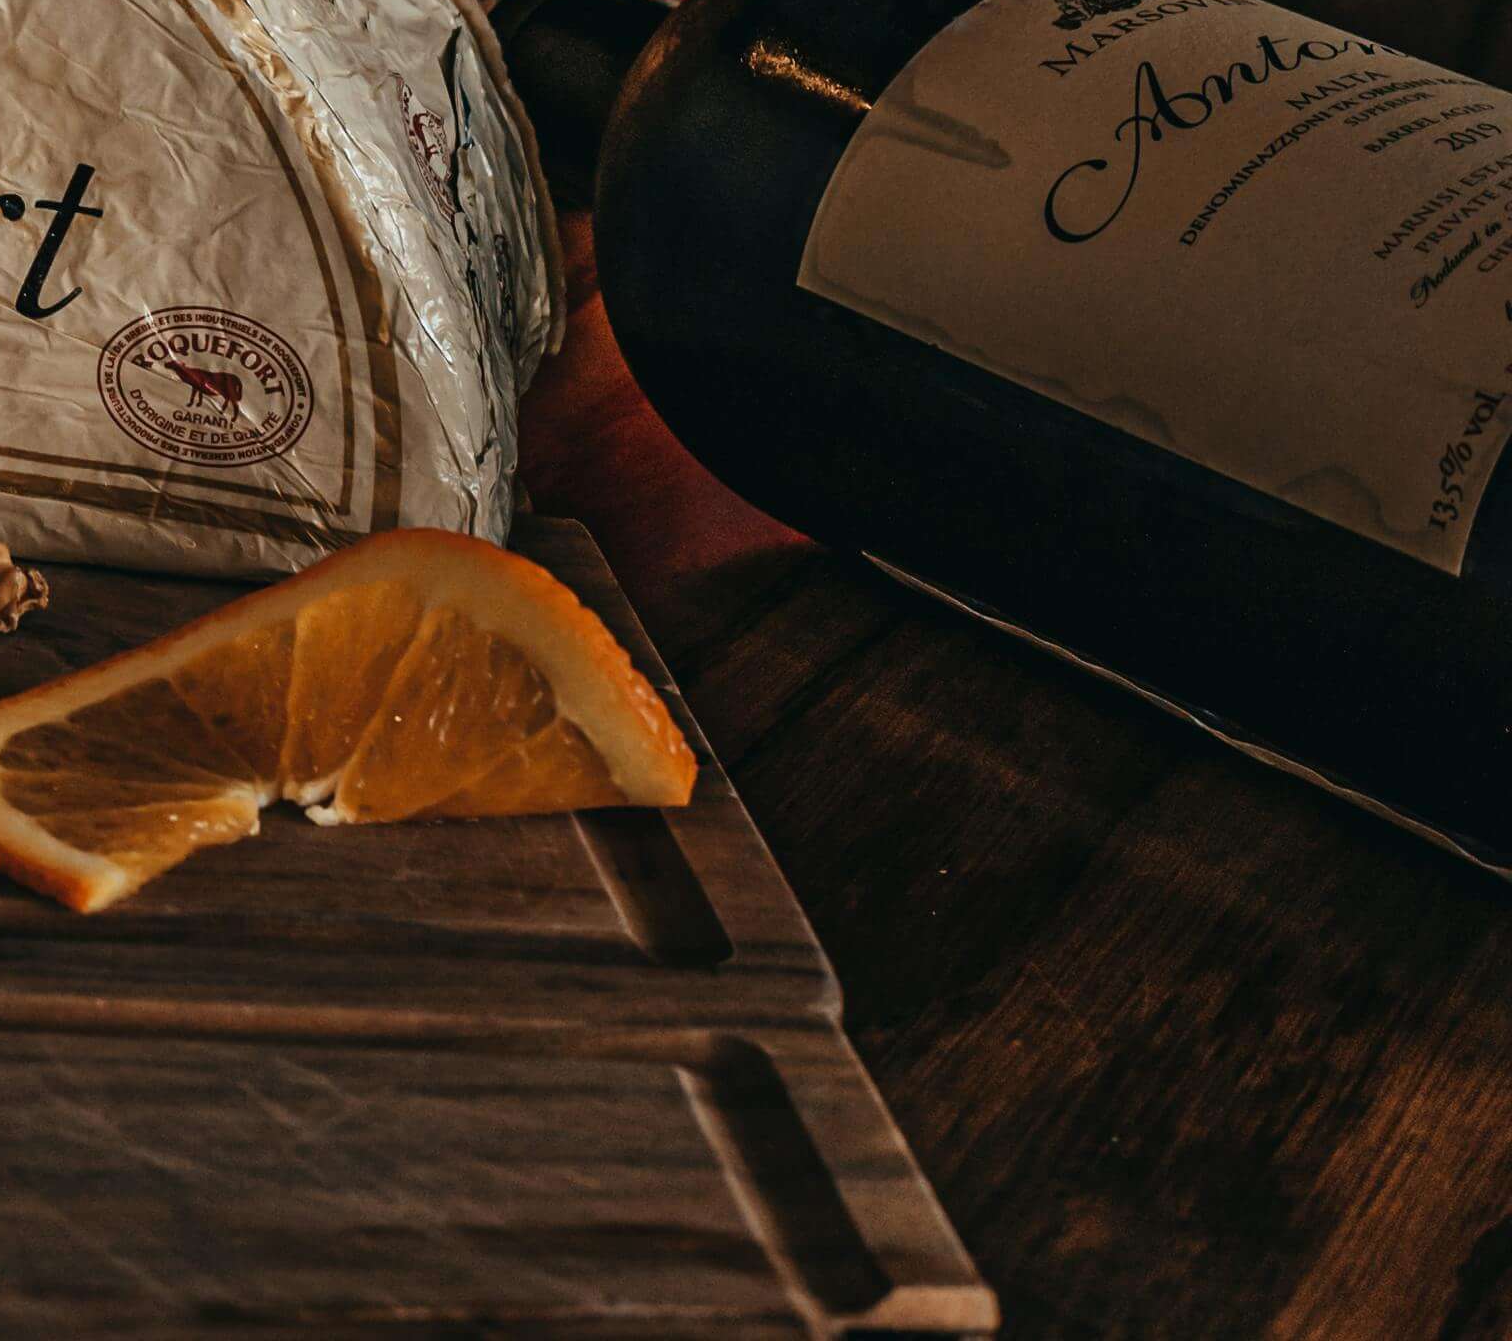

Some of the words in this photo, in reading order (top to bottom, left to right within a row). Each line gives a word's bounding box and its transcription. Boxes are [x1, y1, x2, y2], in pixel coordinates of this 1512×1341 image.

[1283, 68, 1392, 111] MALTA
[1343, 90, 1439, 128] SUPERIOR
[1363, 115, 1443, 155] BARREL
[1434, 121, 1503, 153] 2019
[1179, 110, 1330, 247] DENOMINAZZJONI
[1373, 186, 1462, 260] MARNISI
[1414, 189, 1499, 254] PRIVATE
[130, 333, 287, 399] ROQUEFORT
[129, 388, 187, 438] D'ORIGINE
[188, 429, 206, 443] ET
[210, 432, 231, 445] DE
[1428, 442, 1473, 533] 13.5%
